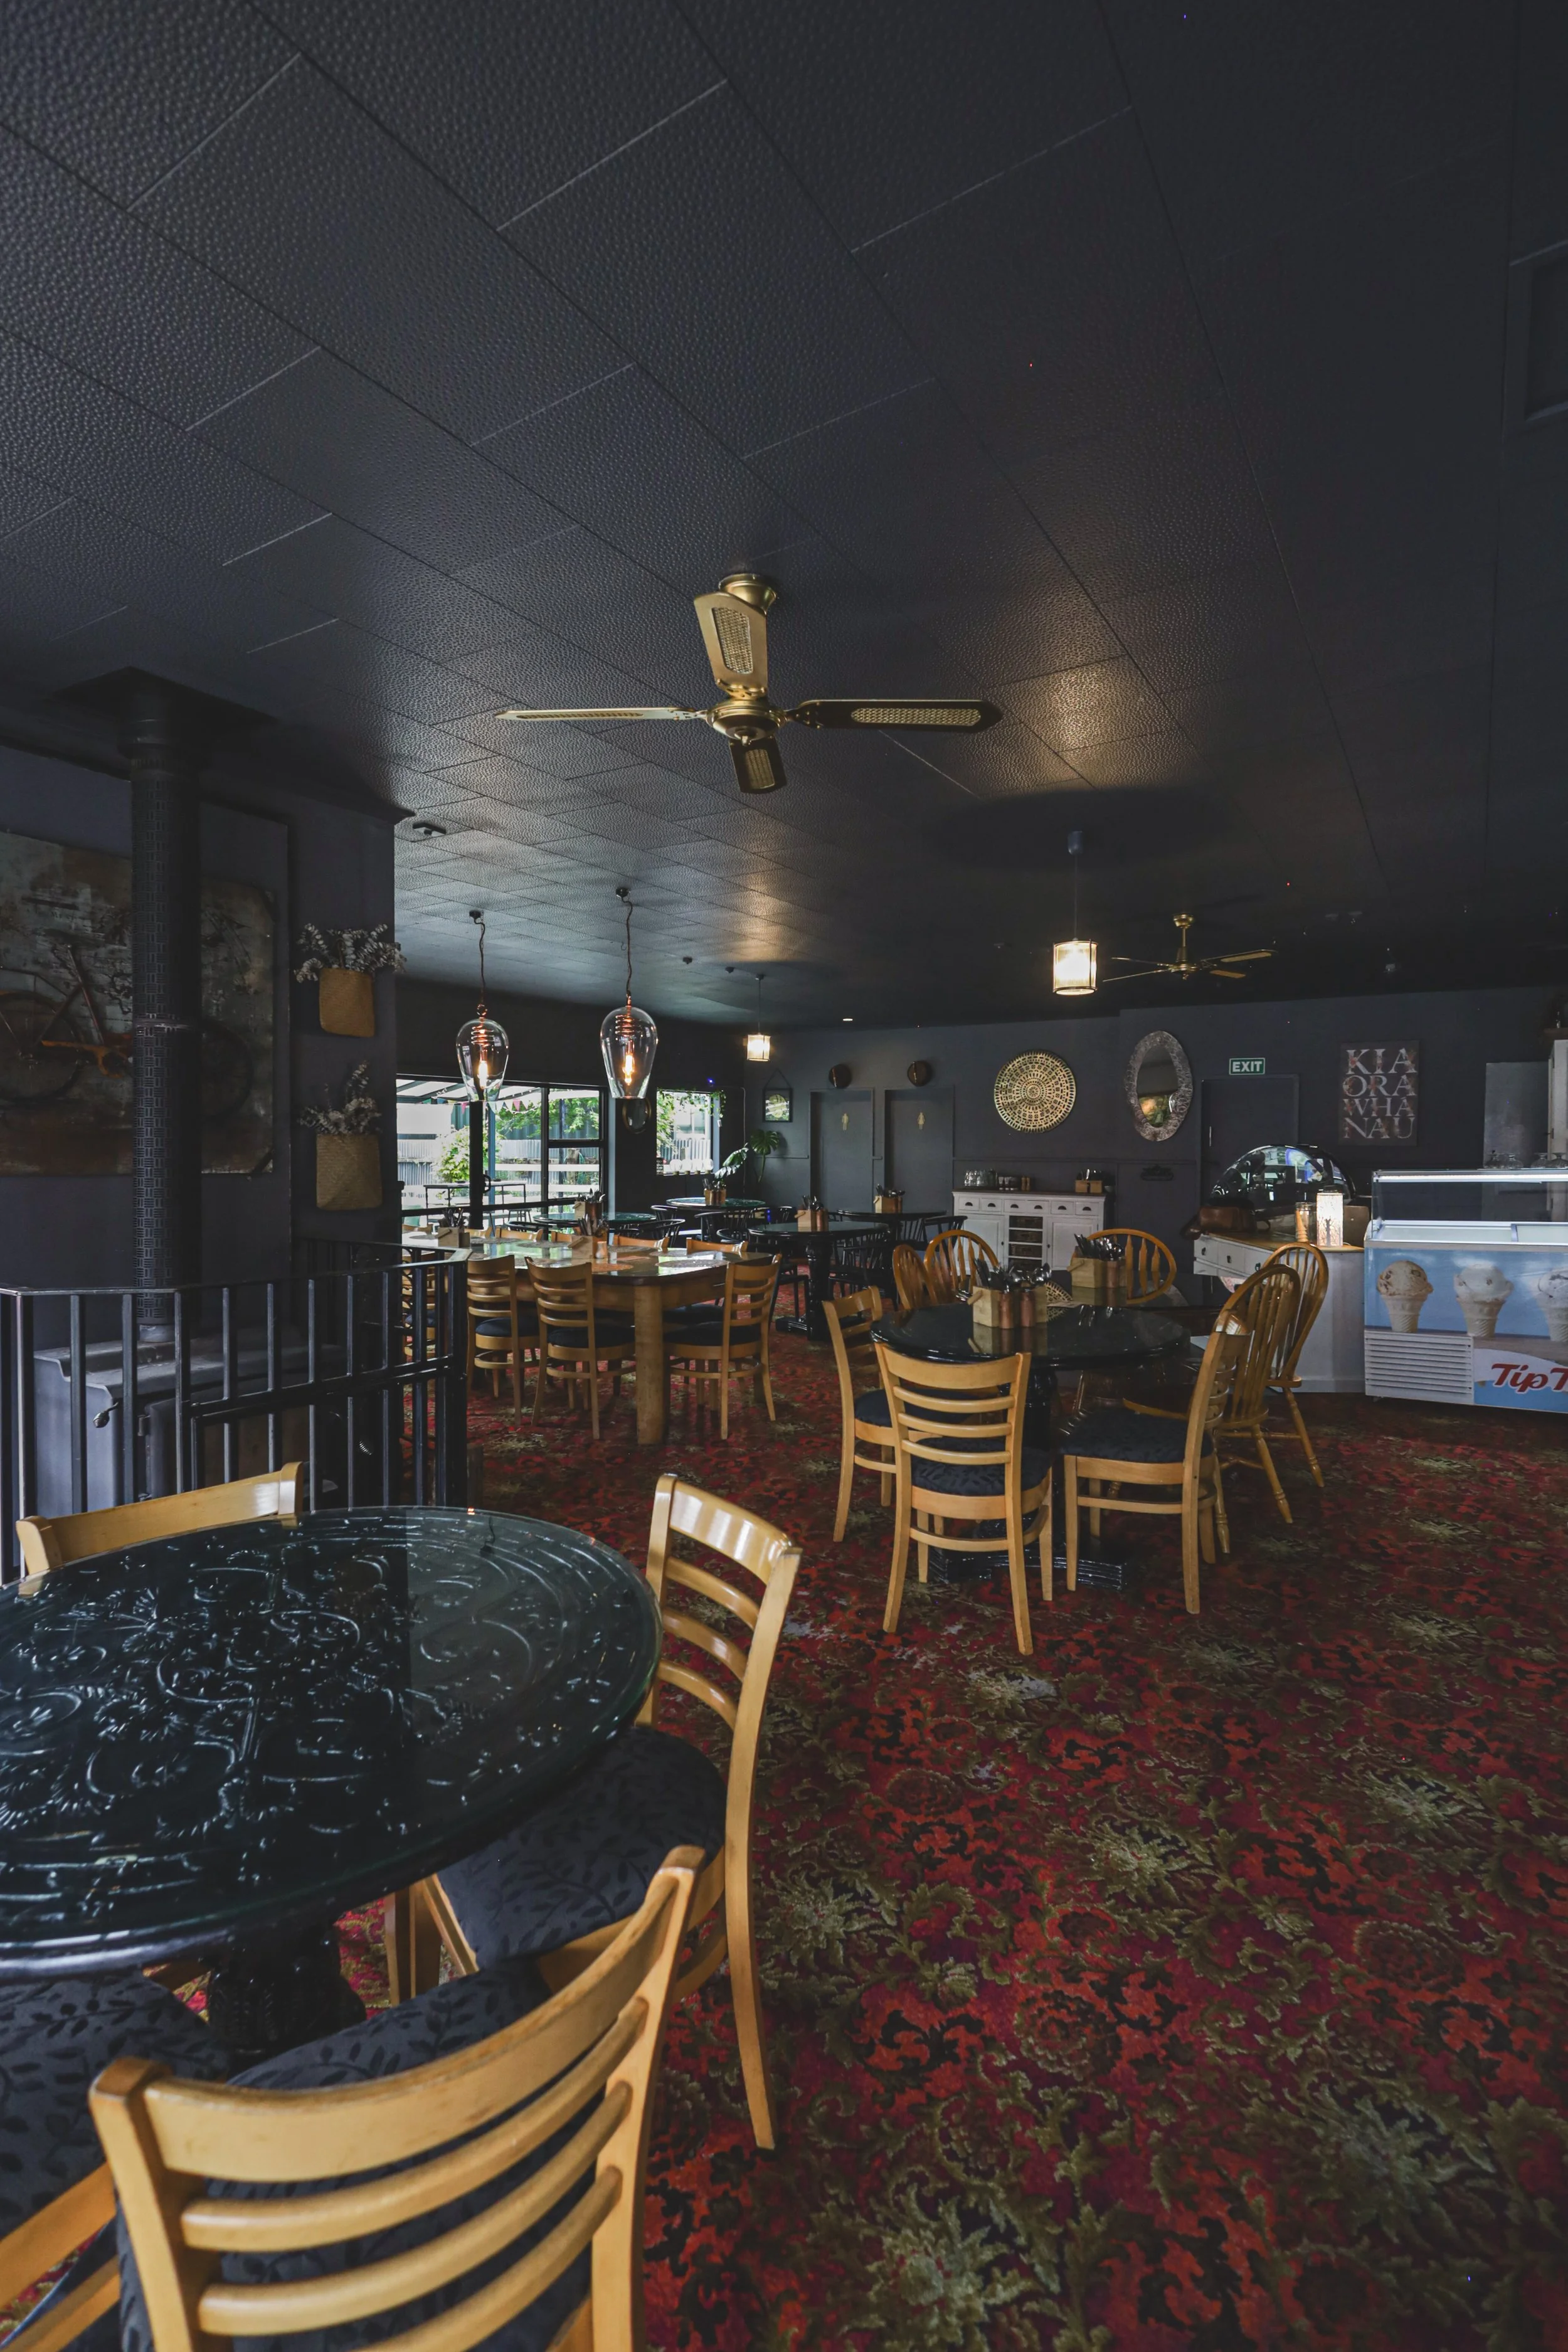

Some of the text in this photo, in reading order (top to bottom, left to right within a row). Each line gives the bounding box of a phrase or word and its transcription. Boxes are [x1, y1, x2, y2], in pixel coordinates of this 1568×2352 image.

[1232, 1061, 1263, 1072] EXIT
[1346, 1047, 1417, 1074] KIA
[1342, 1074, 1417, 1097] ORA
[1343, 1116, 1416, 1139] NAU
[1491, 1363, 1549, 1393] Tip
